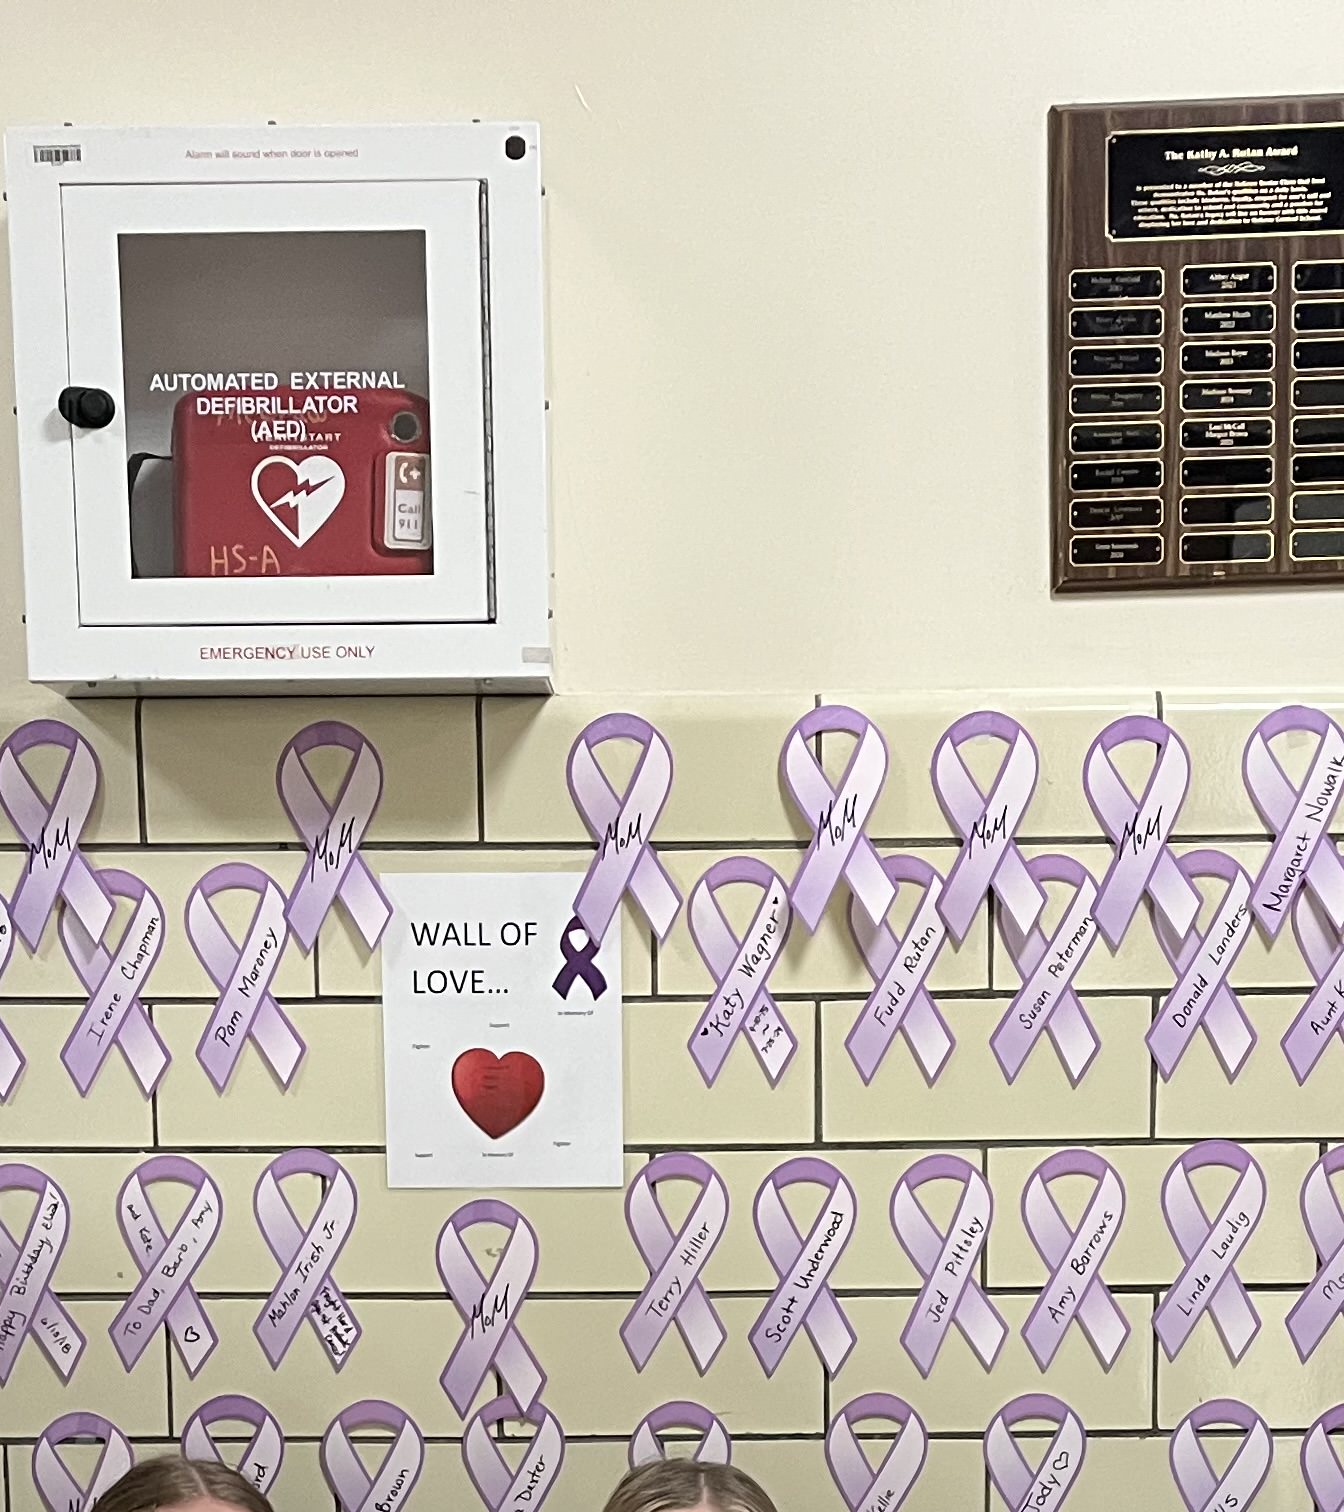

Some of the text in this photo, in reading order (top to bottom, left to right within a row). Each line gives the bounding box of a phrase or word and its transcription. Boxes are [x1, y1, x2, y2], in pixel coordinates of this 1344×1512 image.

[149, 371, 405, 391] AUTOMATED EXTERNAL
[196, 395, 358, 415] DEFIBRILLATOR
[250, 419, 306, 442] (AED)
[398, 504, 421, 515] Call
[209, 545, 281, 575] HS-A
[199, 645, 375, 661] EMERGENCY USE ONLY
[1263, 832, 1312, 913] Margaret
[411, 922, 538, 947] WALL OF
[87, 917, 159, 1046] Irene Chapman
[237, 927, 278, 998] Maroney
[709, 909, 780, 1037] Katy Wagner
[1018, 916, 1094, 1030] Susan Peterman
[1172, 903, 1248, 1029] Donald Landers
[413, 970, 508, 995] LOVE...
[1310, 1000, 1340, 1036] Aunt
[295, 1242, 324, 1283] Irish
[645, 1220, 711, 1319] Terry Hiller
[765, 1210, 844, 1344] Scott Underwood
[1046, 1210, 1114, 1324] Amy Barrows
[1177, 1210, 1250, 1317] Linda Laudig
[925, 1289, 950, 1324] Jed
[123, 1320, 142, 1337] To
